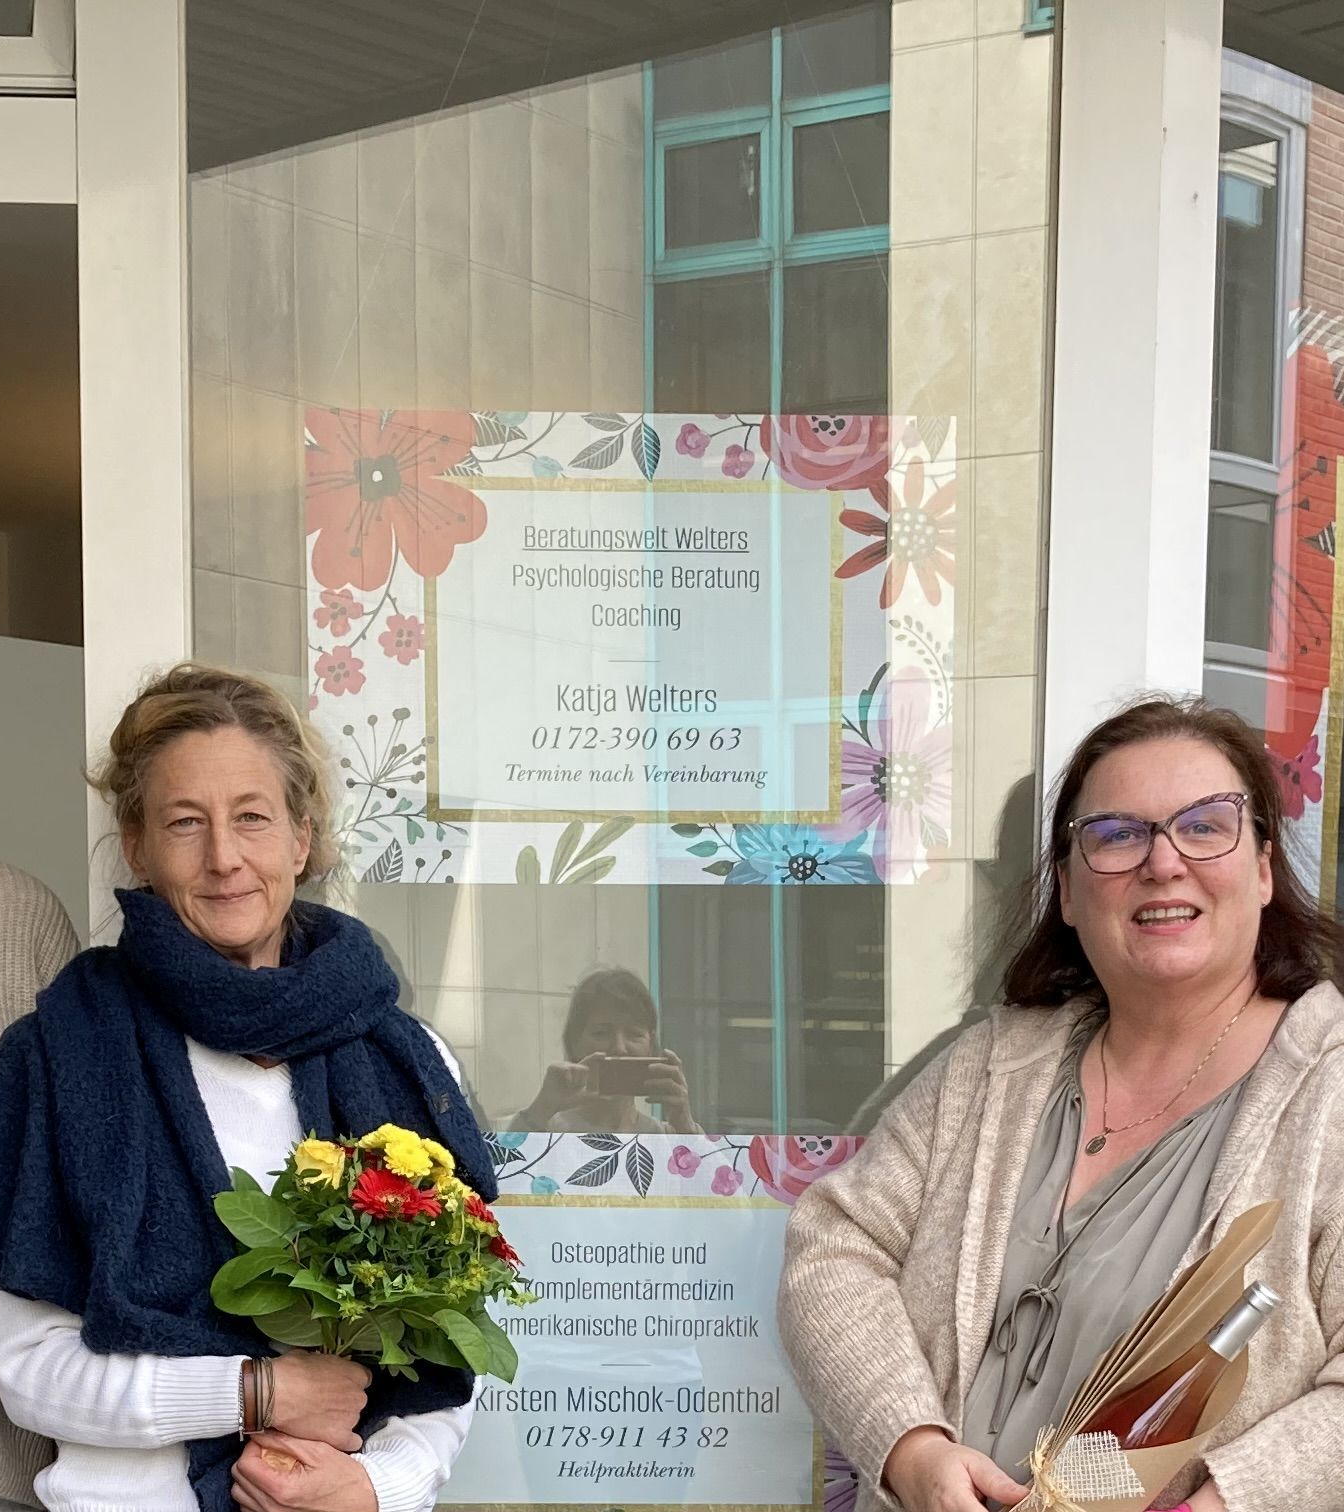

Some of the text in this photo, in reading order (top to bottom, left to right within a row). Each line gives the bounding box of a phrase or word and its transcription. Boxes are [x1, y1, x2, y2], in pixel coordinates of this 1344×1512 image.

[523, 525, 748, 551] Beratungswelt Welters
[512, 564, 760, 593] Psychologische Beratung
[591, 603, 682, 631] Coaching
[557, 683, 717, 716] Katja Welters
[531, 726, 743, 751] 0172-390 69 63
[505, 763, 768, 790] Termine nach Vereinbarung
[551, 1241, 706, 1267] Osteopathie und
[524, 1278, 734, 1304] Komplementärmedizin
[498, 1314, 759, 1340] amerikanische Chiropraktik
[475, 1385, 780, 1414] Kirsten Mischok-Odenthal
[526, 1425, 729, 1449] 0178-911 43 82
[557, 1460, 697, 1484] Heilpraktikerin
